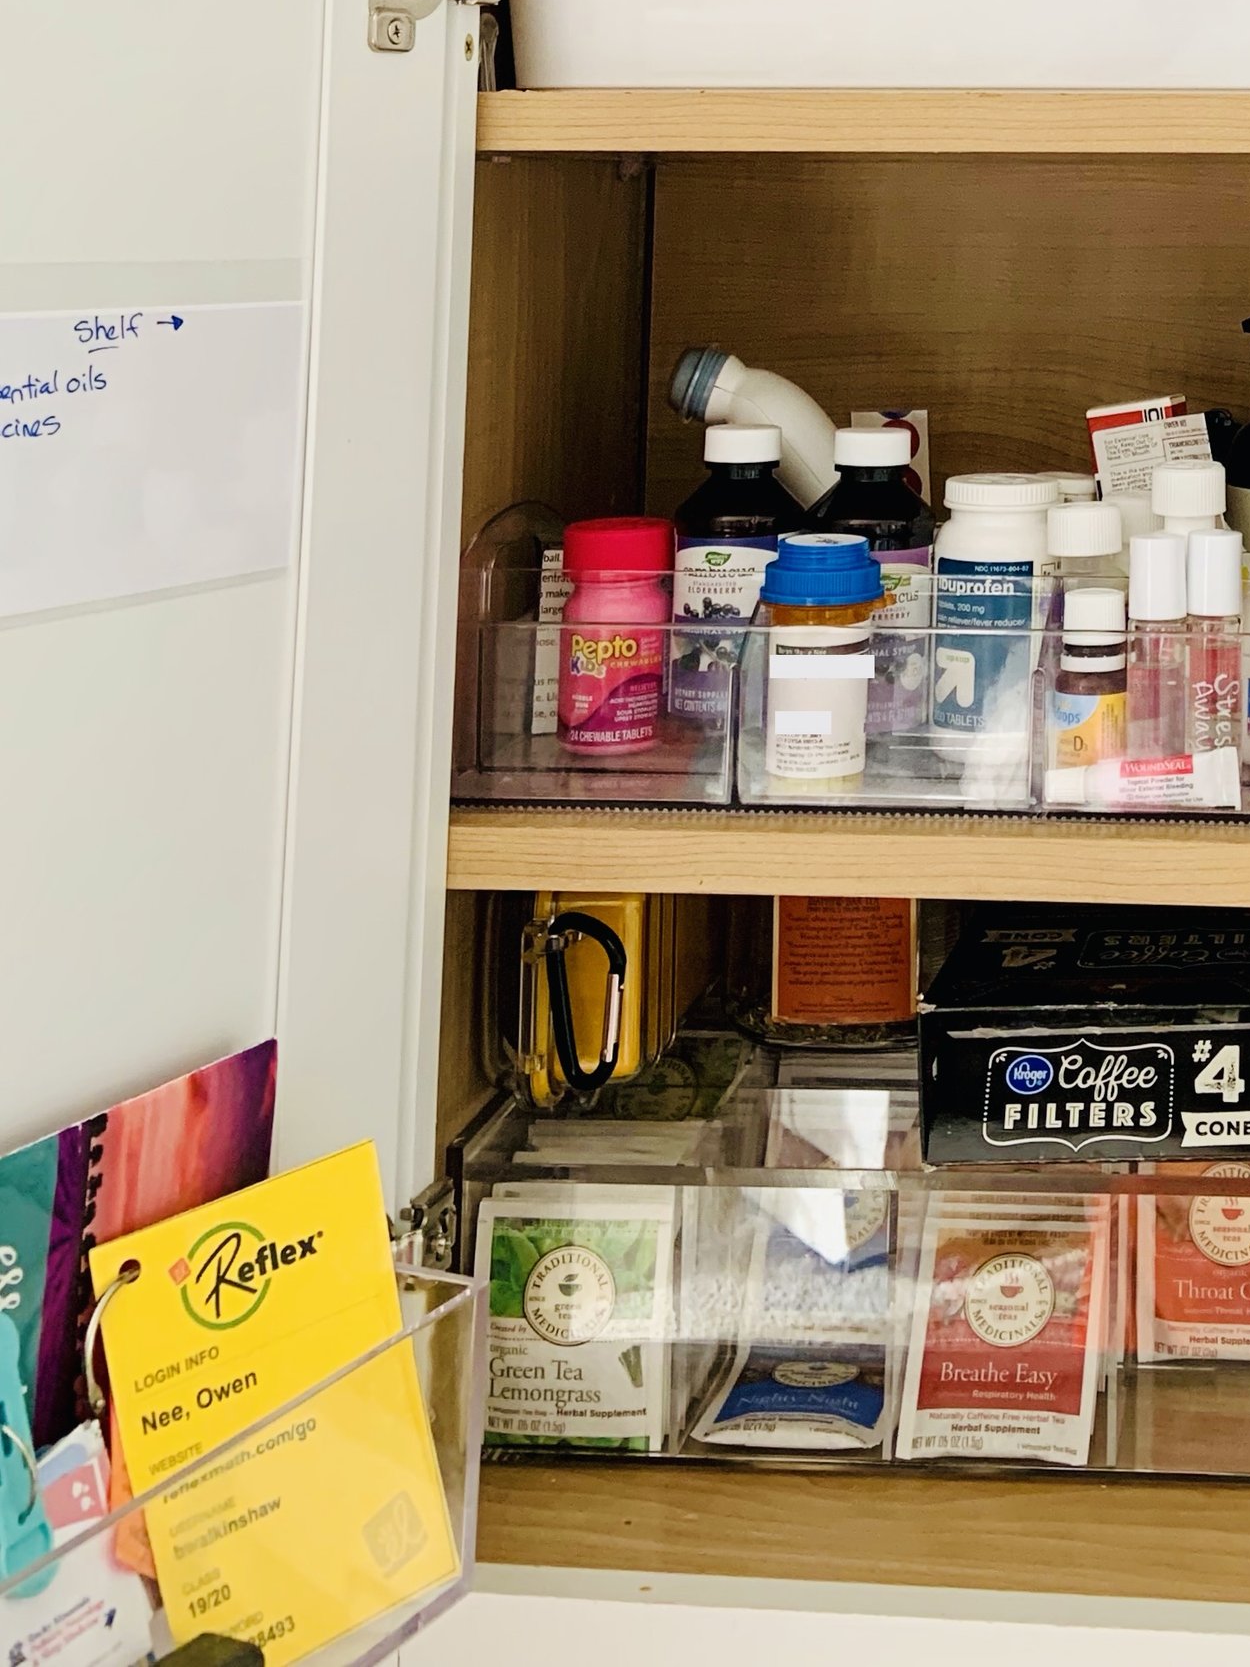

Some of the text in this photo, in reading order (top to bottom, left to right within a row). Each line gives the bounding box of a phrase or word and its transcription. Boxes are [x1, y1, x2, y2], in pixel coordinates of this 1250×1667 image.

[74, 313, 143, 343] Shelf
[66, 365, 108, 395] oils
[975, 565, 988, 573] NDC
[546, 589, 570, 598] make
[688, 586, 743, 594] ELDERBERRY
[957, 603, 985, 615] 200 mg
[994, 618, 1025, 627] reducer
[572, 634, 638, 665] Pepto
[946, 714, 985, 728] TABLETS
[579, 726, 653, 743] CHEWABLE TABLETS
[1166, 782, 1194, 791] Bleeding
[1014, 1055, 1157, 1101] Kroger Coffee
[1192, 1040, 1246, 1103] #4
[1003, 1101, 1157, 1130] FILTERS
[1213, 1224, 1250, 1233] seasonal
[1222, 1234, 1241, 1242] teas
[195, 1232, 318, 1319] Reflex
[533, 1252, 610, 1290] TRADITIONAL
[1173, 1279, 1235, 1300] Throat
[988, 1302, 1029, 1312] seasonal
[972, 1309, 1044, 1341] MEDICINALS
[997, 1312, 1018, 1322] teas
[1189, 1335, 1218, 1344] Herbal
[490, 1344, 528, 1359] organic
[134, 1345, 220, 1393] LOGIN INFO
[489, 1356, 584, 1381] Green Tea
[940, 1361, 1057, 1391] Breathe Easy
[489, 1377, 602, 1409] Lemongrass
[972, 1389, 1056, 1402] Respiratory Health
[141, 1371, 258, 1436] Nee, Owen
[556, 1407, 648, 1419] Herbal Supplement
[929, 1412, 1066, 1425] Naturally Caffeine Free Herbal Tea
[951, 1423, 1041, 1435] Herbal Supplement
[148, 1441, 204, 1476] WEBSITE
[187, 1584, 232, 1619] 19/20
